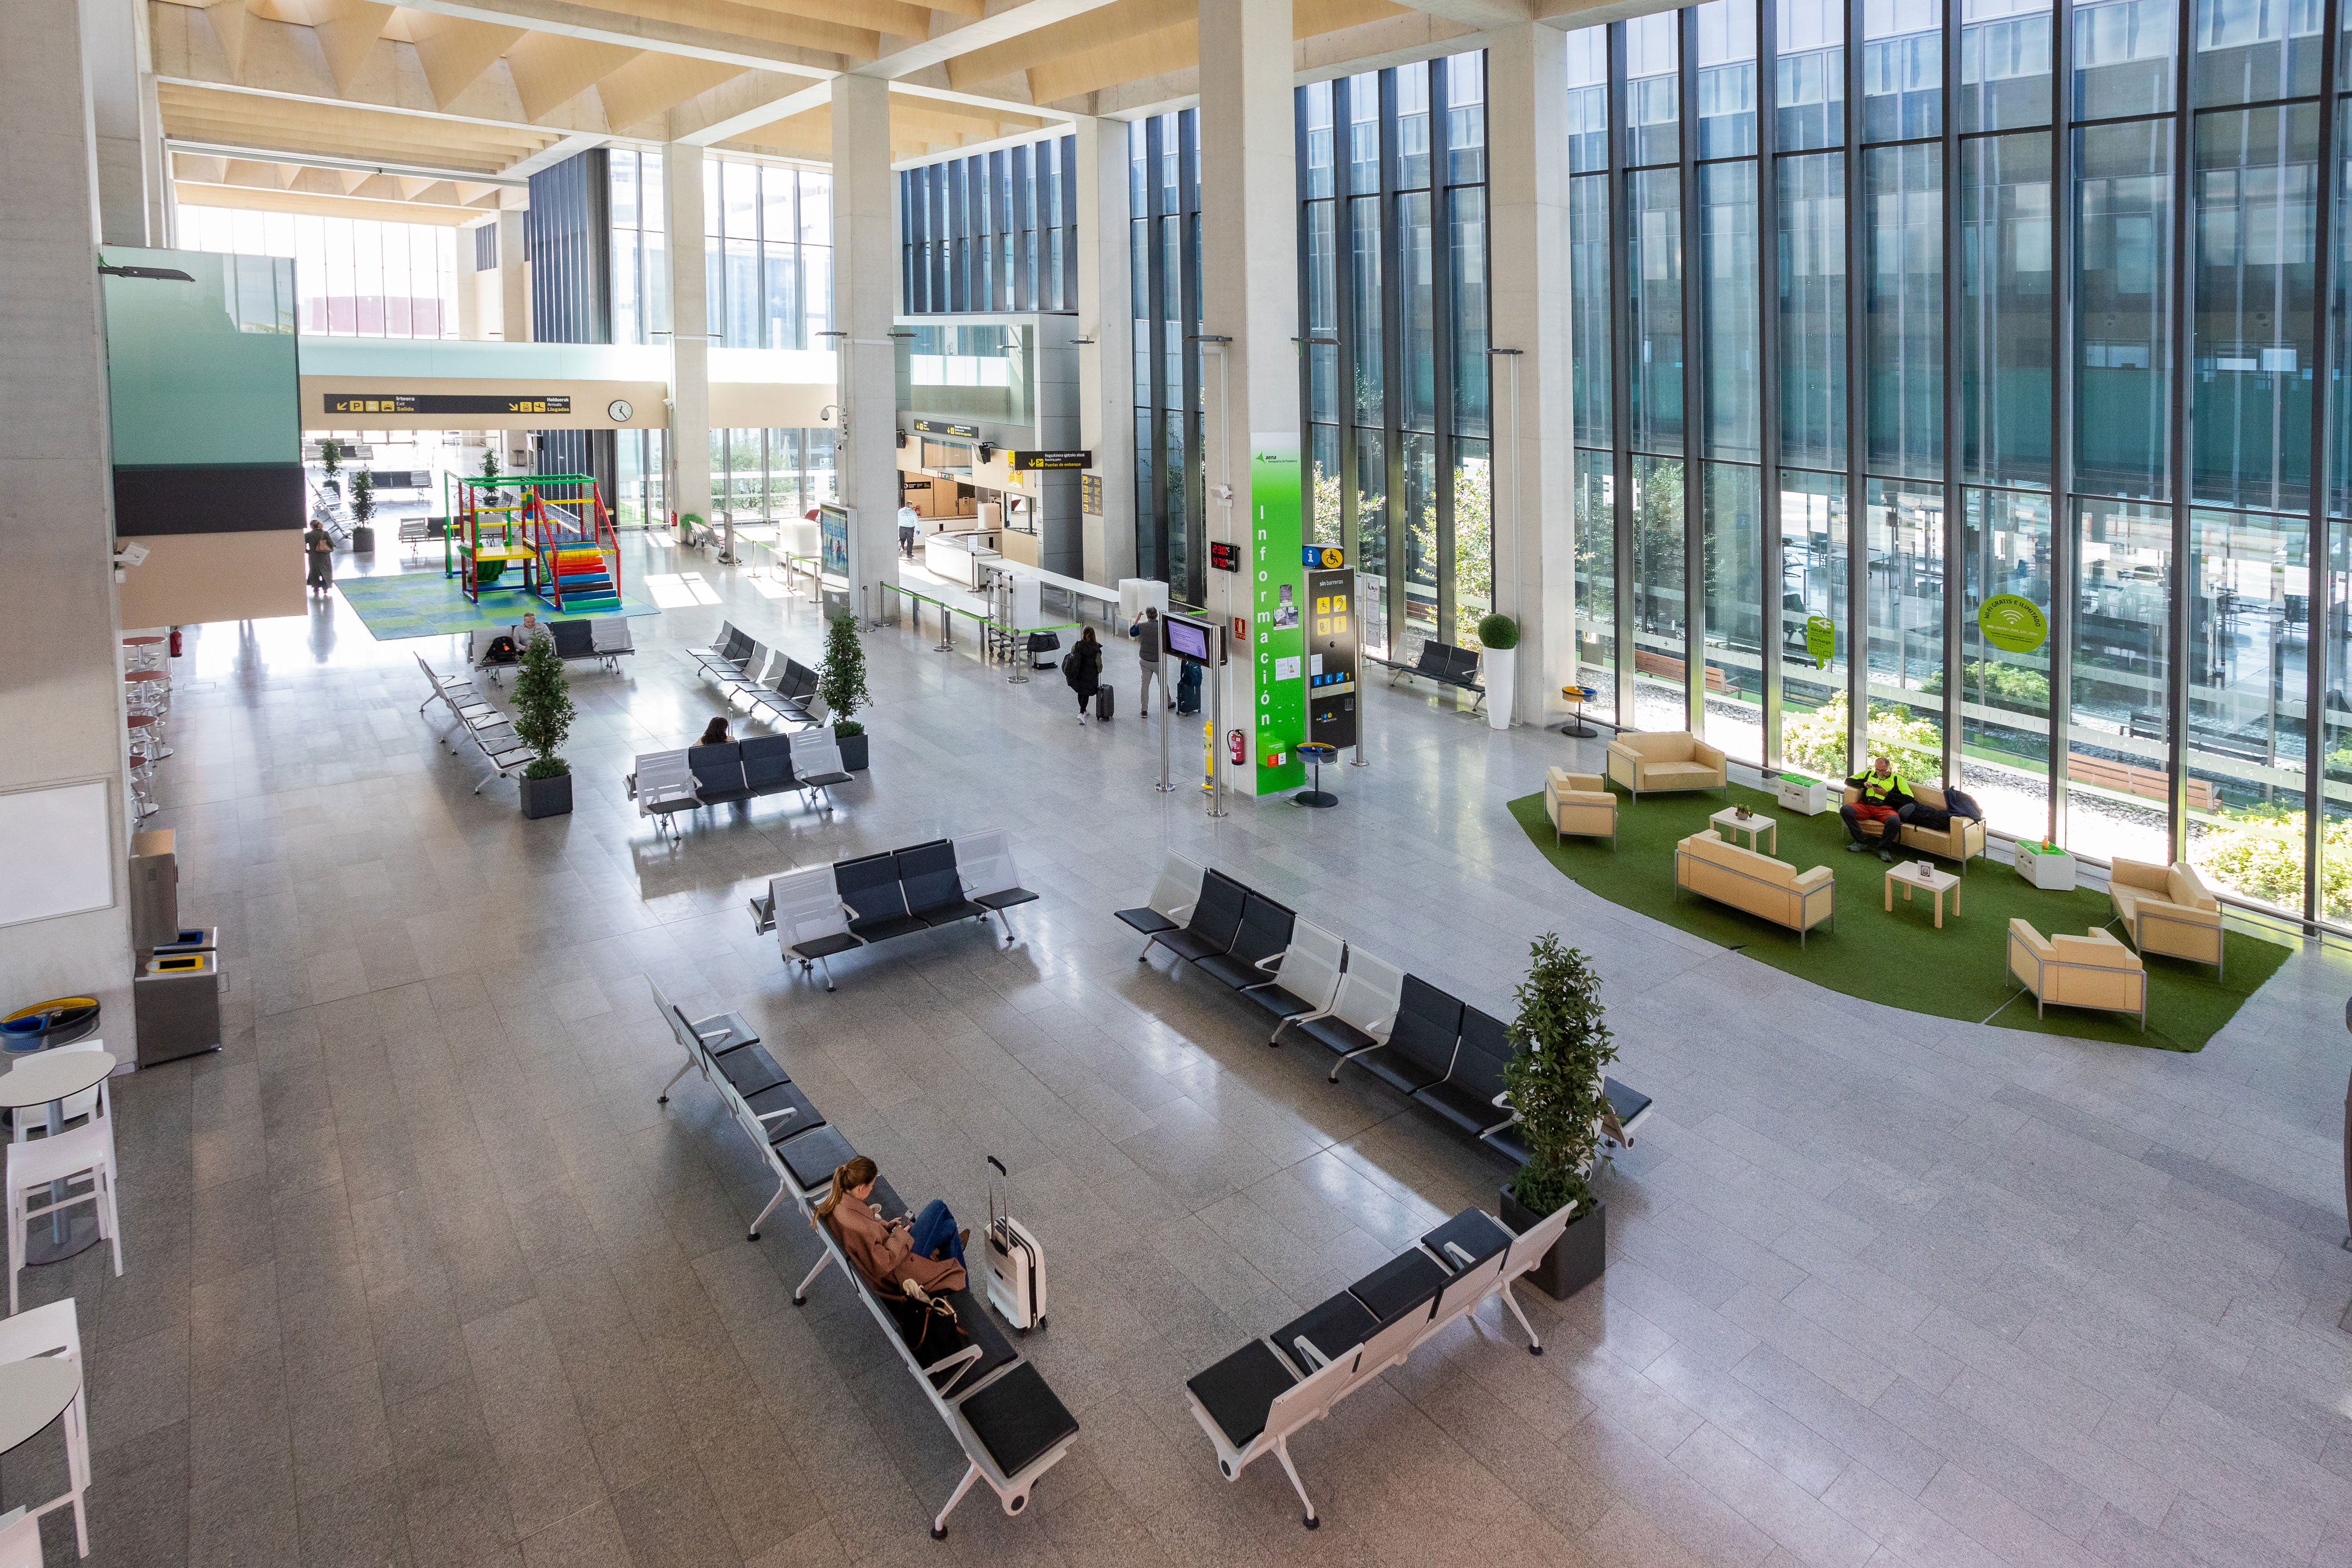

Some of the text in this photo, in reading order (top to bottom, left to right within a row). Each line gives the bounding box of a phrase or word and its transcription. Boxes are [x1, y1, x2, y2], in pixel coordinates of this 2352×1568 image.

[825, 521, 846, 540] WELCOME
[1984, 606, 1993, 619] WI-FI
[1991, 599, 2012, 607] GRATIS
[2019, 602, 2041, 627] ILIMITADO
